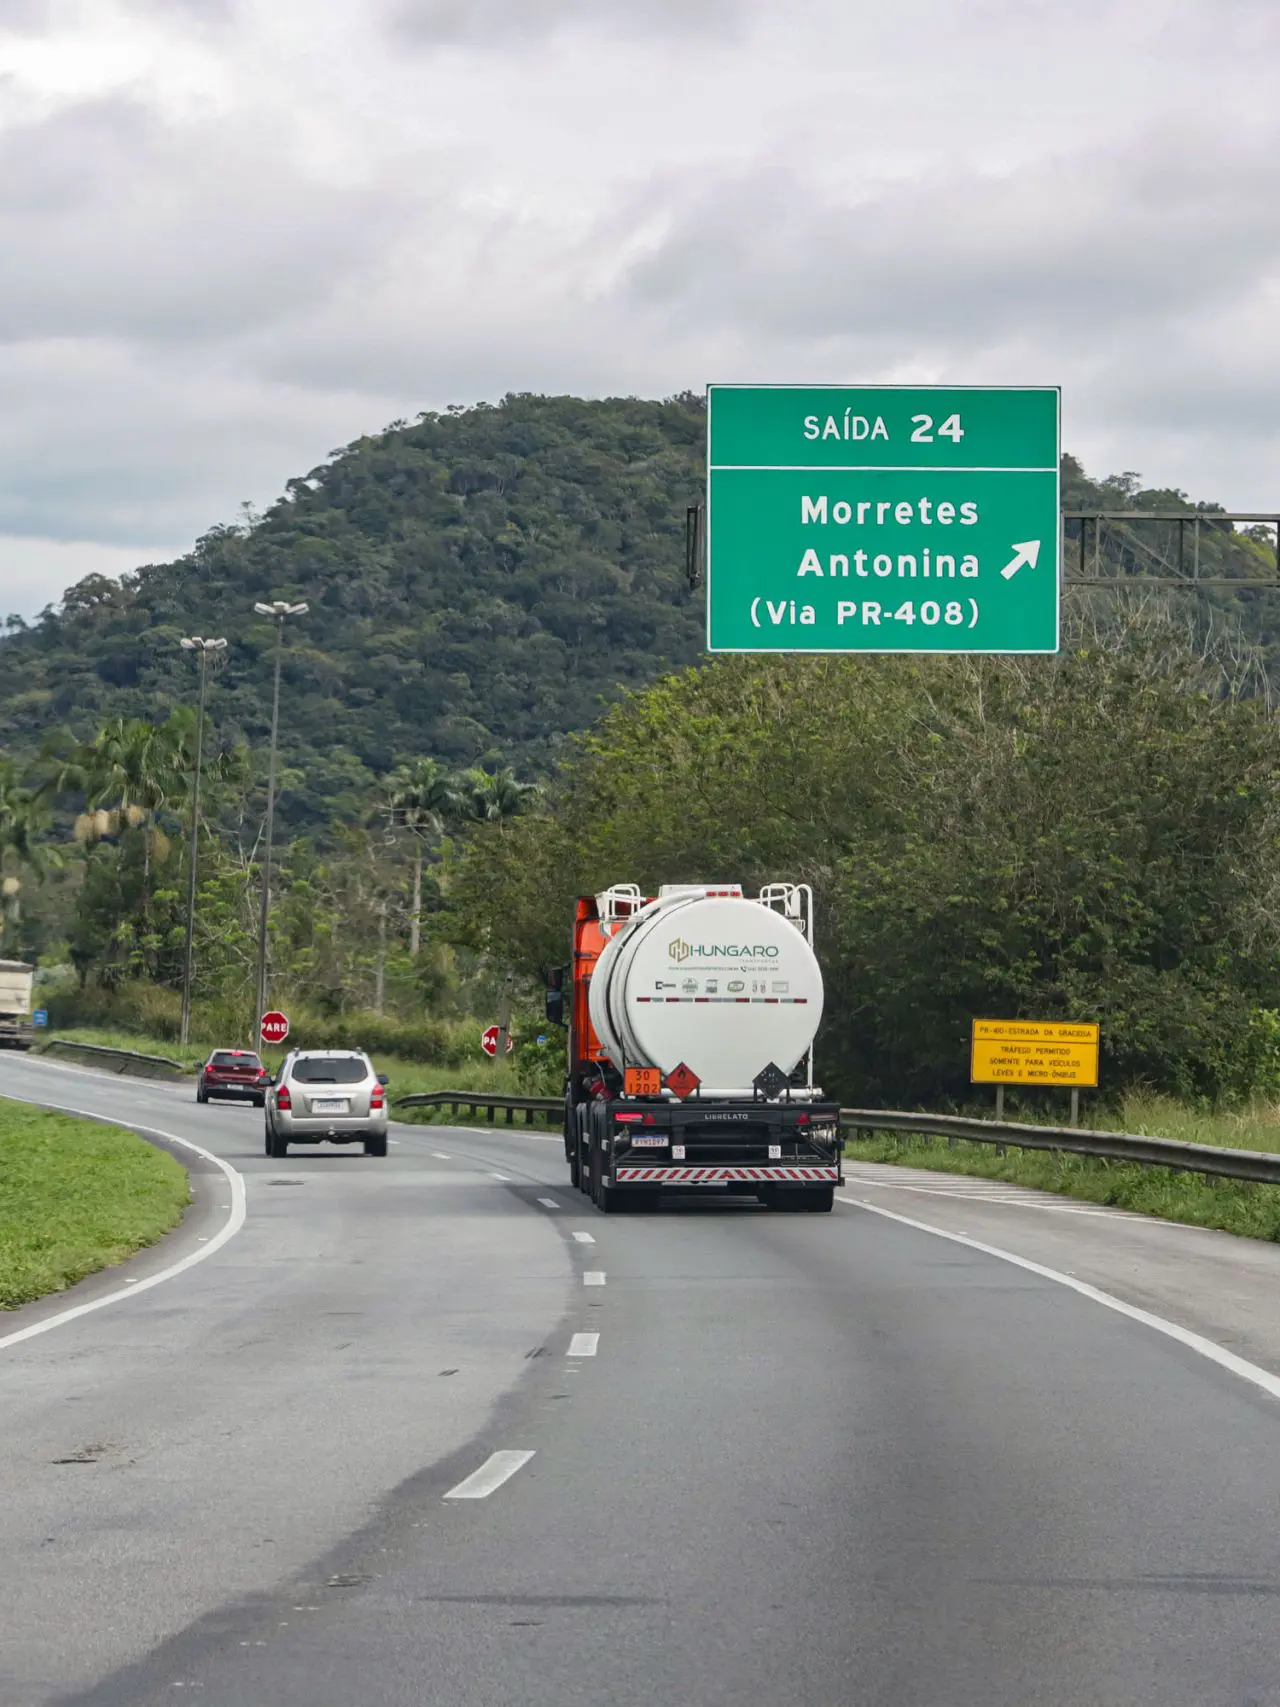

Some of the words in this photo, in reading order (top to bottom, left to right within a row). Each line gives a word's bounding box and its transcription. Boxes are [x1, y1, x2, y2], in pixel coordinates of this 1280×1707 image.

[803, 407, 889, 441] SAÍDA
[910, 414, 965, 443] 24
[801, 495, 979, 525] Morretes
[797, 548, 979, 578] Antonina
[750, 597, 816, 628] (Via
[837, 598, 979, 629] PR-408)
[690, 944, 779, 958] HUNGARO
[261, 1022, 287, 1033] PARE
[635, 1070, 650, 1081] 30
[629, 1083, 658, 1094] 1202
